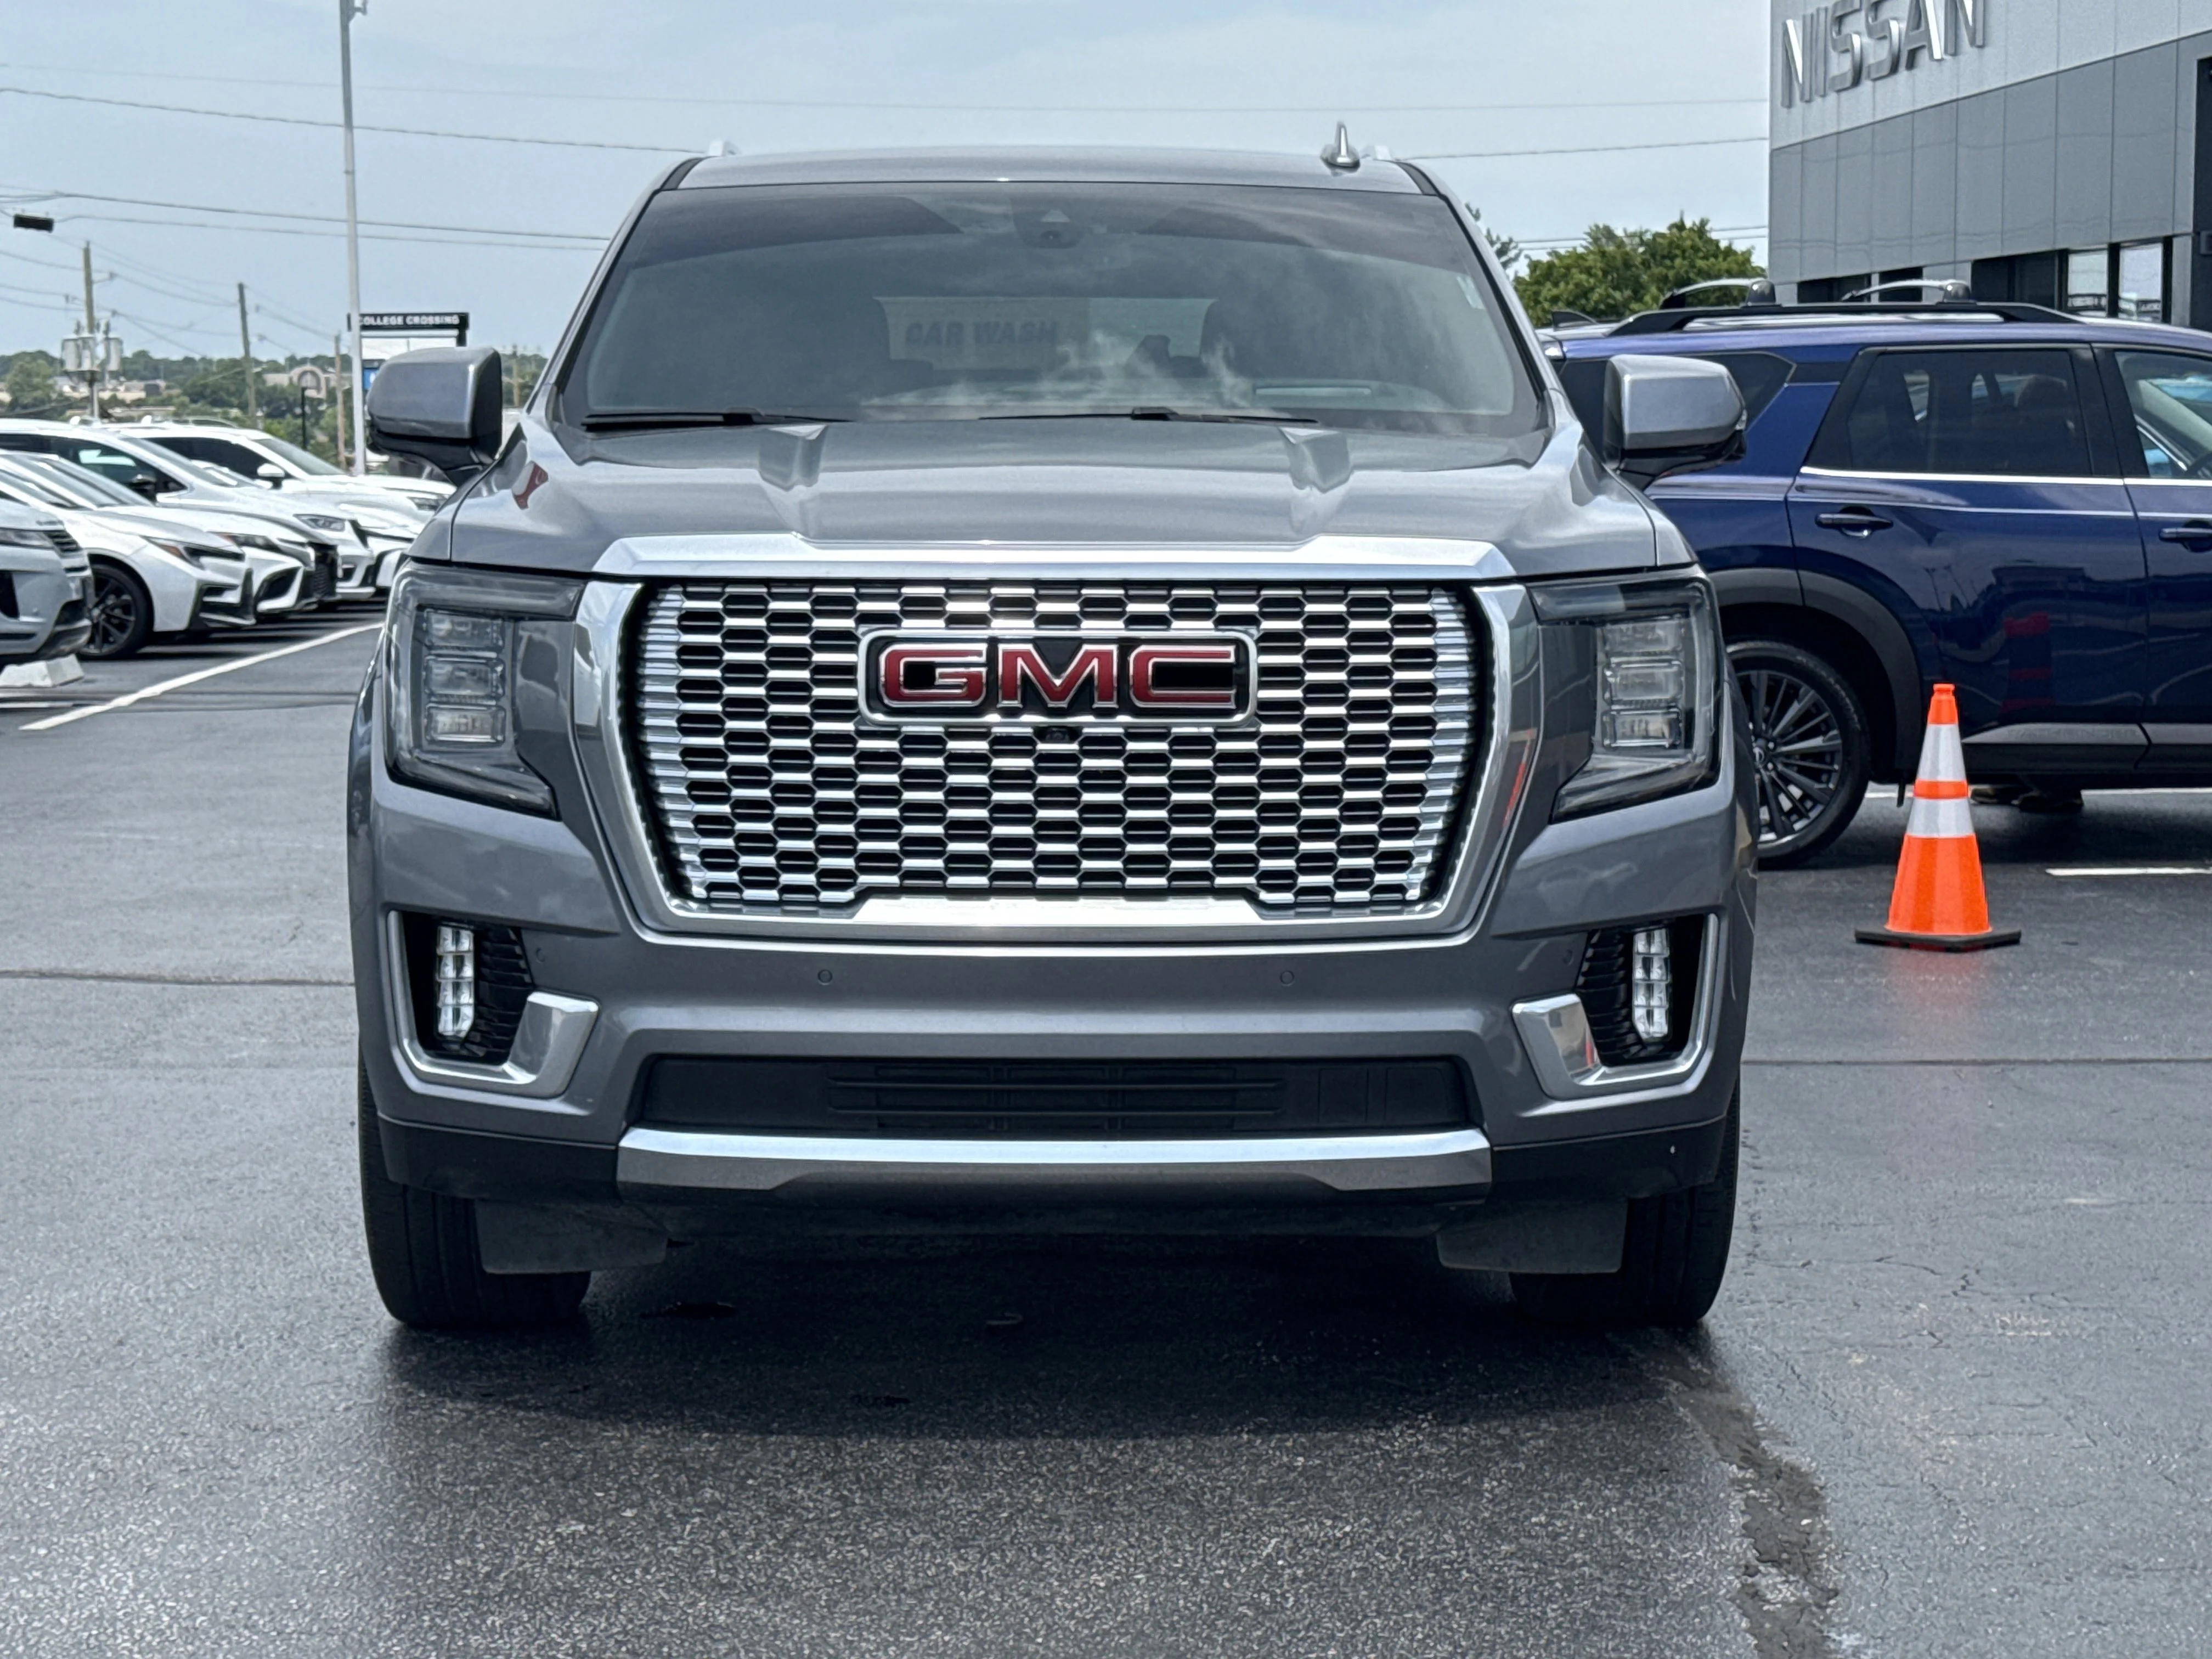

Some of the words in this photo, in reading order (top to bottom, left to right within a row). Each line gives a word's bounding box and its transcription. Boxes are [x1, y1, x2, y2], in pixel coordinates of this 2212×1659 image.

[1781, 0, 1985, 109] NISSAN
[405, 314, 460, 325] CROSSING
[906, 321, 964, 345] CAR
[972, 321, 1058, 345] WASH
[879, 643, 1235, 709] GMC
